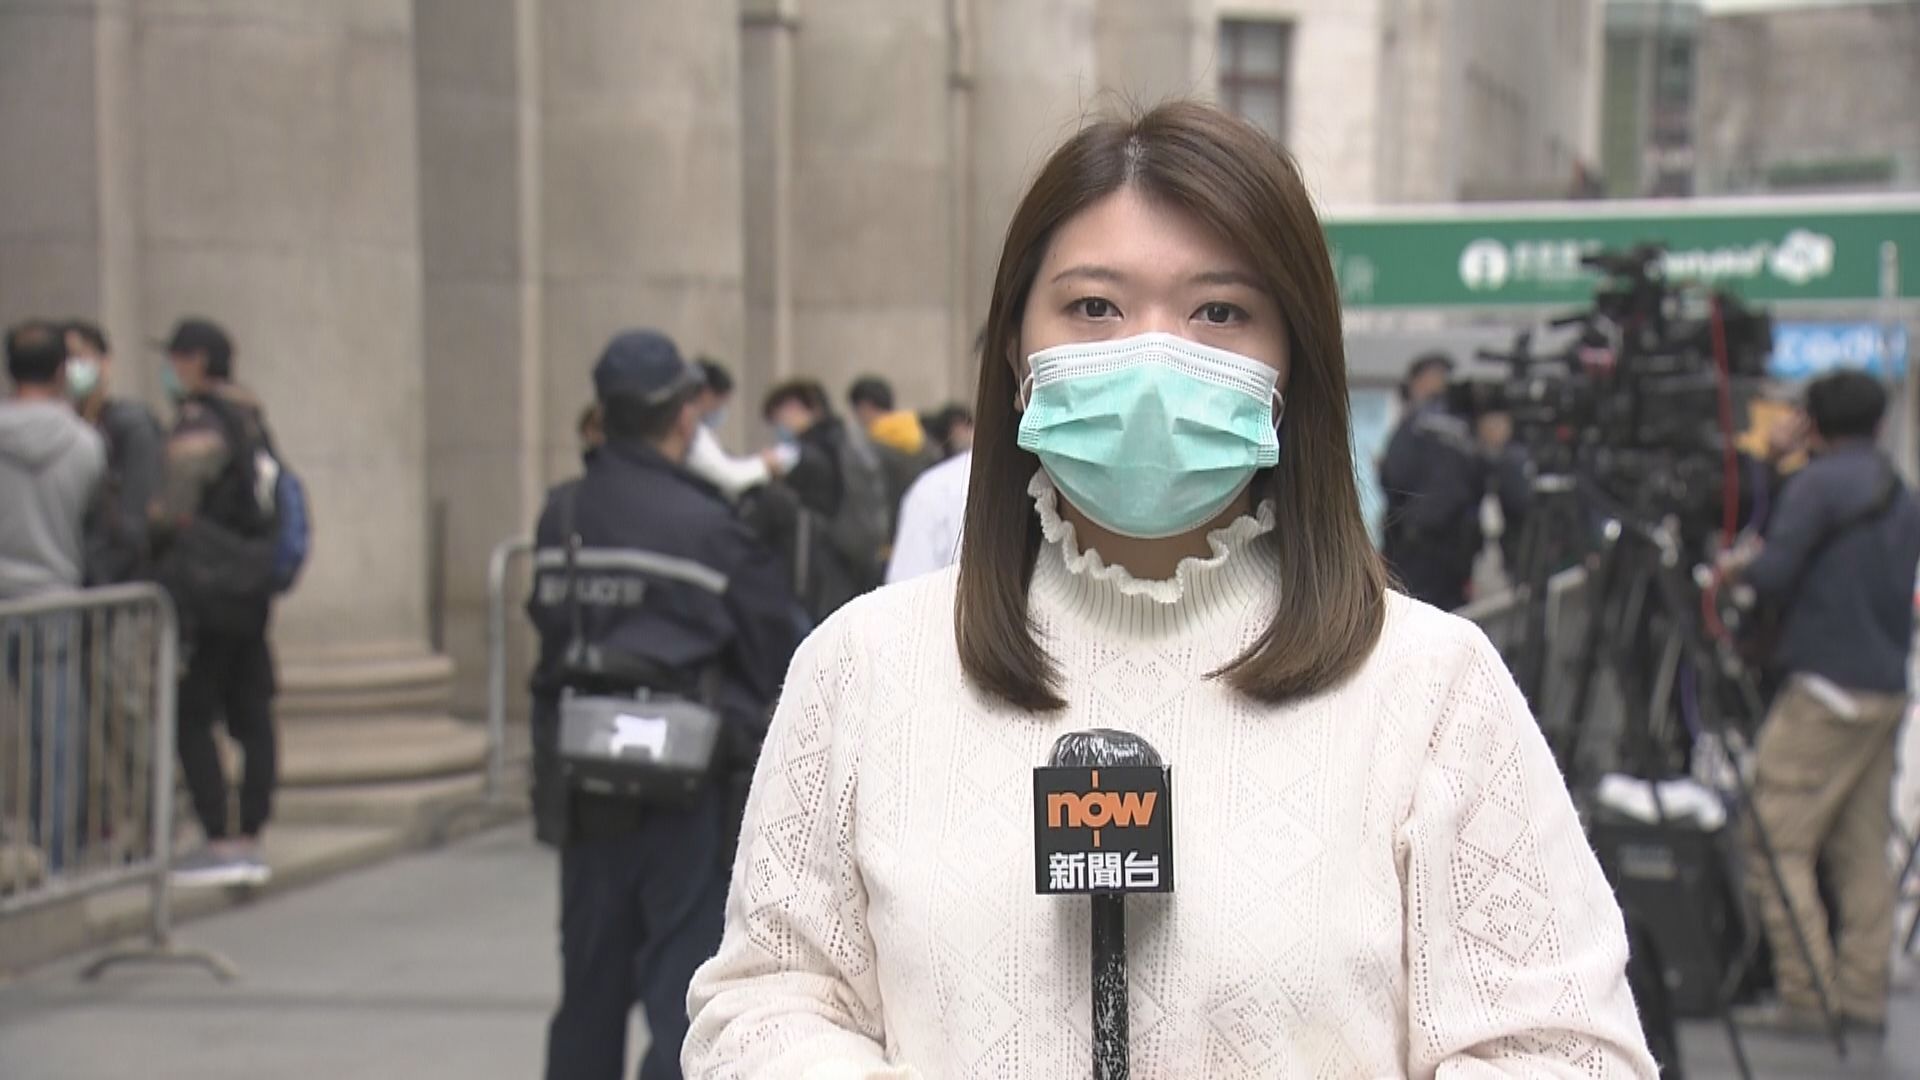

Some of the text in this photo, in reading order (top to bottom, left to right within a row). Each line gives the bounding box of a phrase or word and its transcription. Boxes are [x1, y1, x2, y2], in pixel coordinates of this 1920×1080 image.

[1047, 791, 1157, 828] now
[1048, 851, 1160, 889] 新聞台
